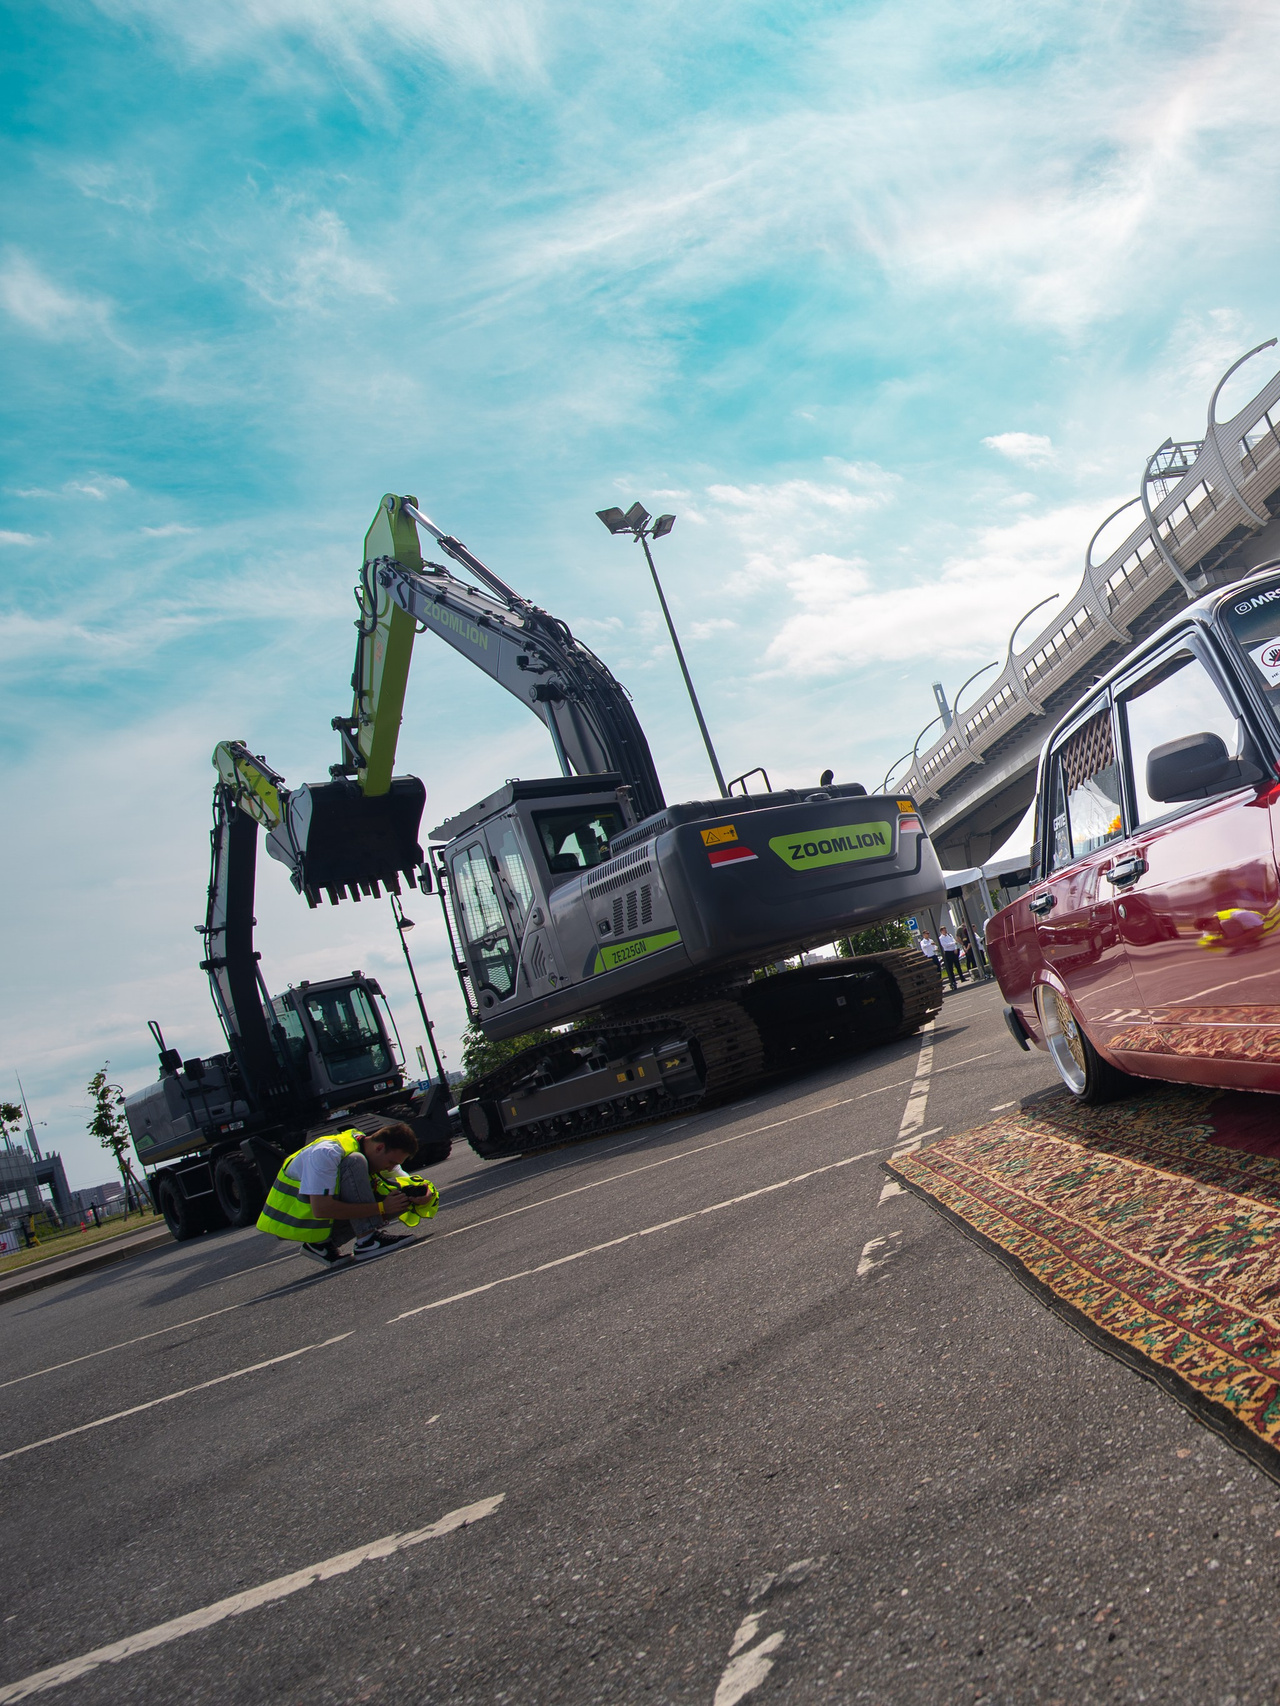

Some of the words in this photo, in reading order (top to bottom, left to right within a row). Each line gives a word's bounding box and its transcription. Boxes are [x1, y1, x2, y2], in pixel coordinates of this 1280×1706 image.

[423, 598, 489, 650] ZOOMLION
[787, 830, 886, 861] ZOOMLION
[907, 919, 916, 930] P
[612, 940, 647, 964] ZE225GN
[420, 1081, 428, 1090] P
